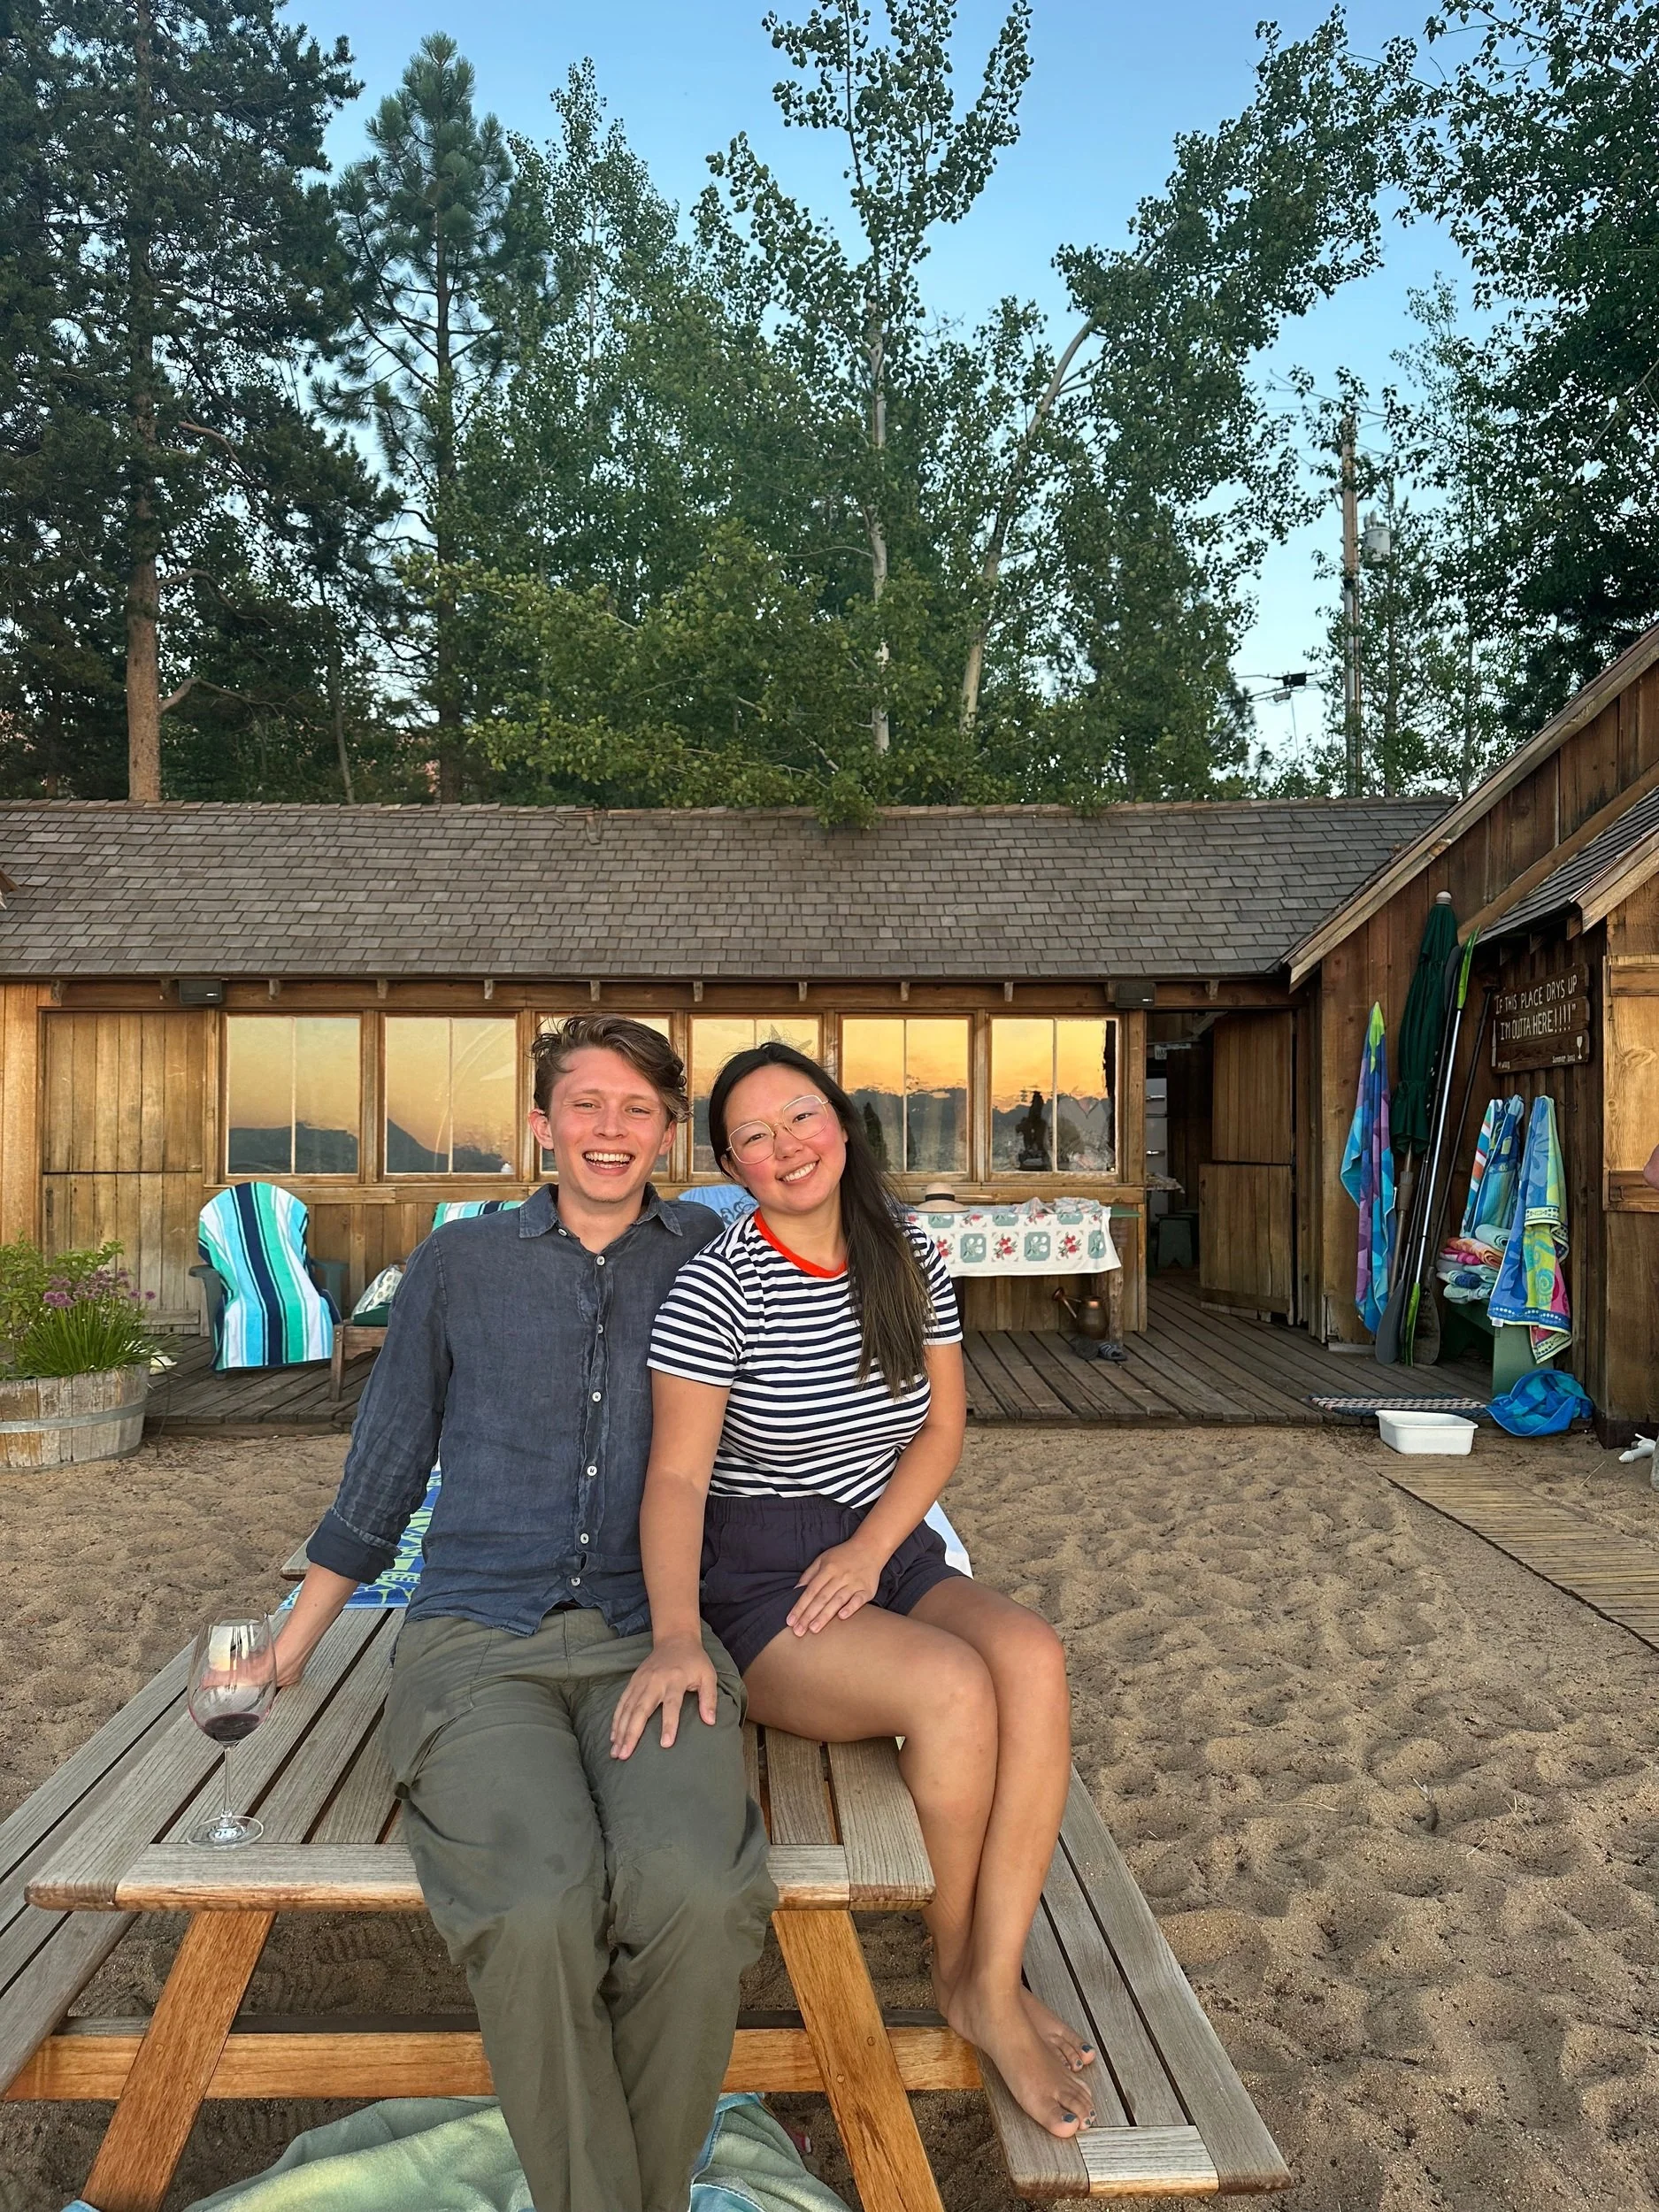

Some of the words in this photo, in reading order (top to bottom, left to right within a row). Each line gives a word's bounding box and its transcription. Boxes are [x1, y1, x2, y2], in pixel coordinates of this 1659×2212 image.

[1505, 993, 1517, 1012] THIS
[1521, 986, 1543, 1009] PLACE
[1547, 979, 1565, 1002] DRYS
[1568, 974, 1578, 995] UP
[1512, 1017, 1532, 1040] OUTTA
